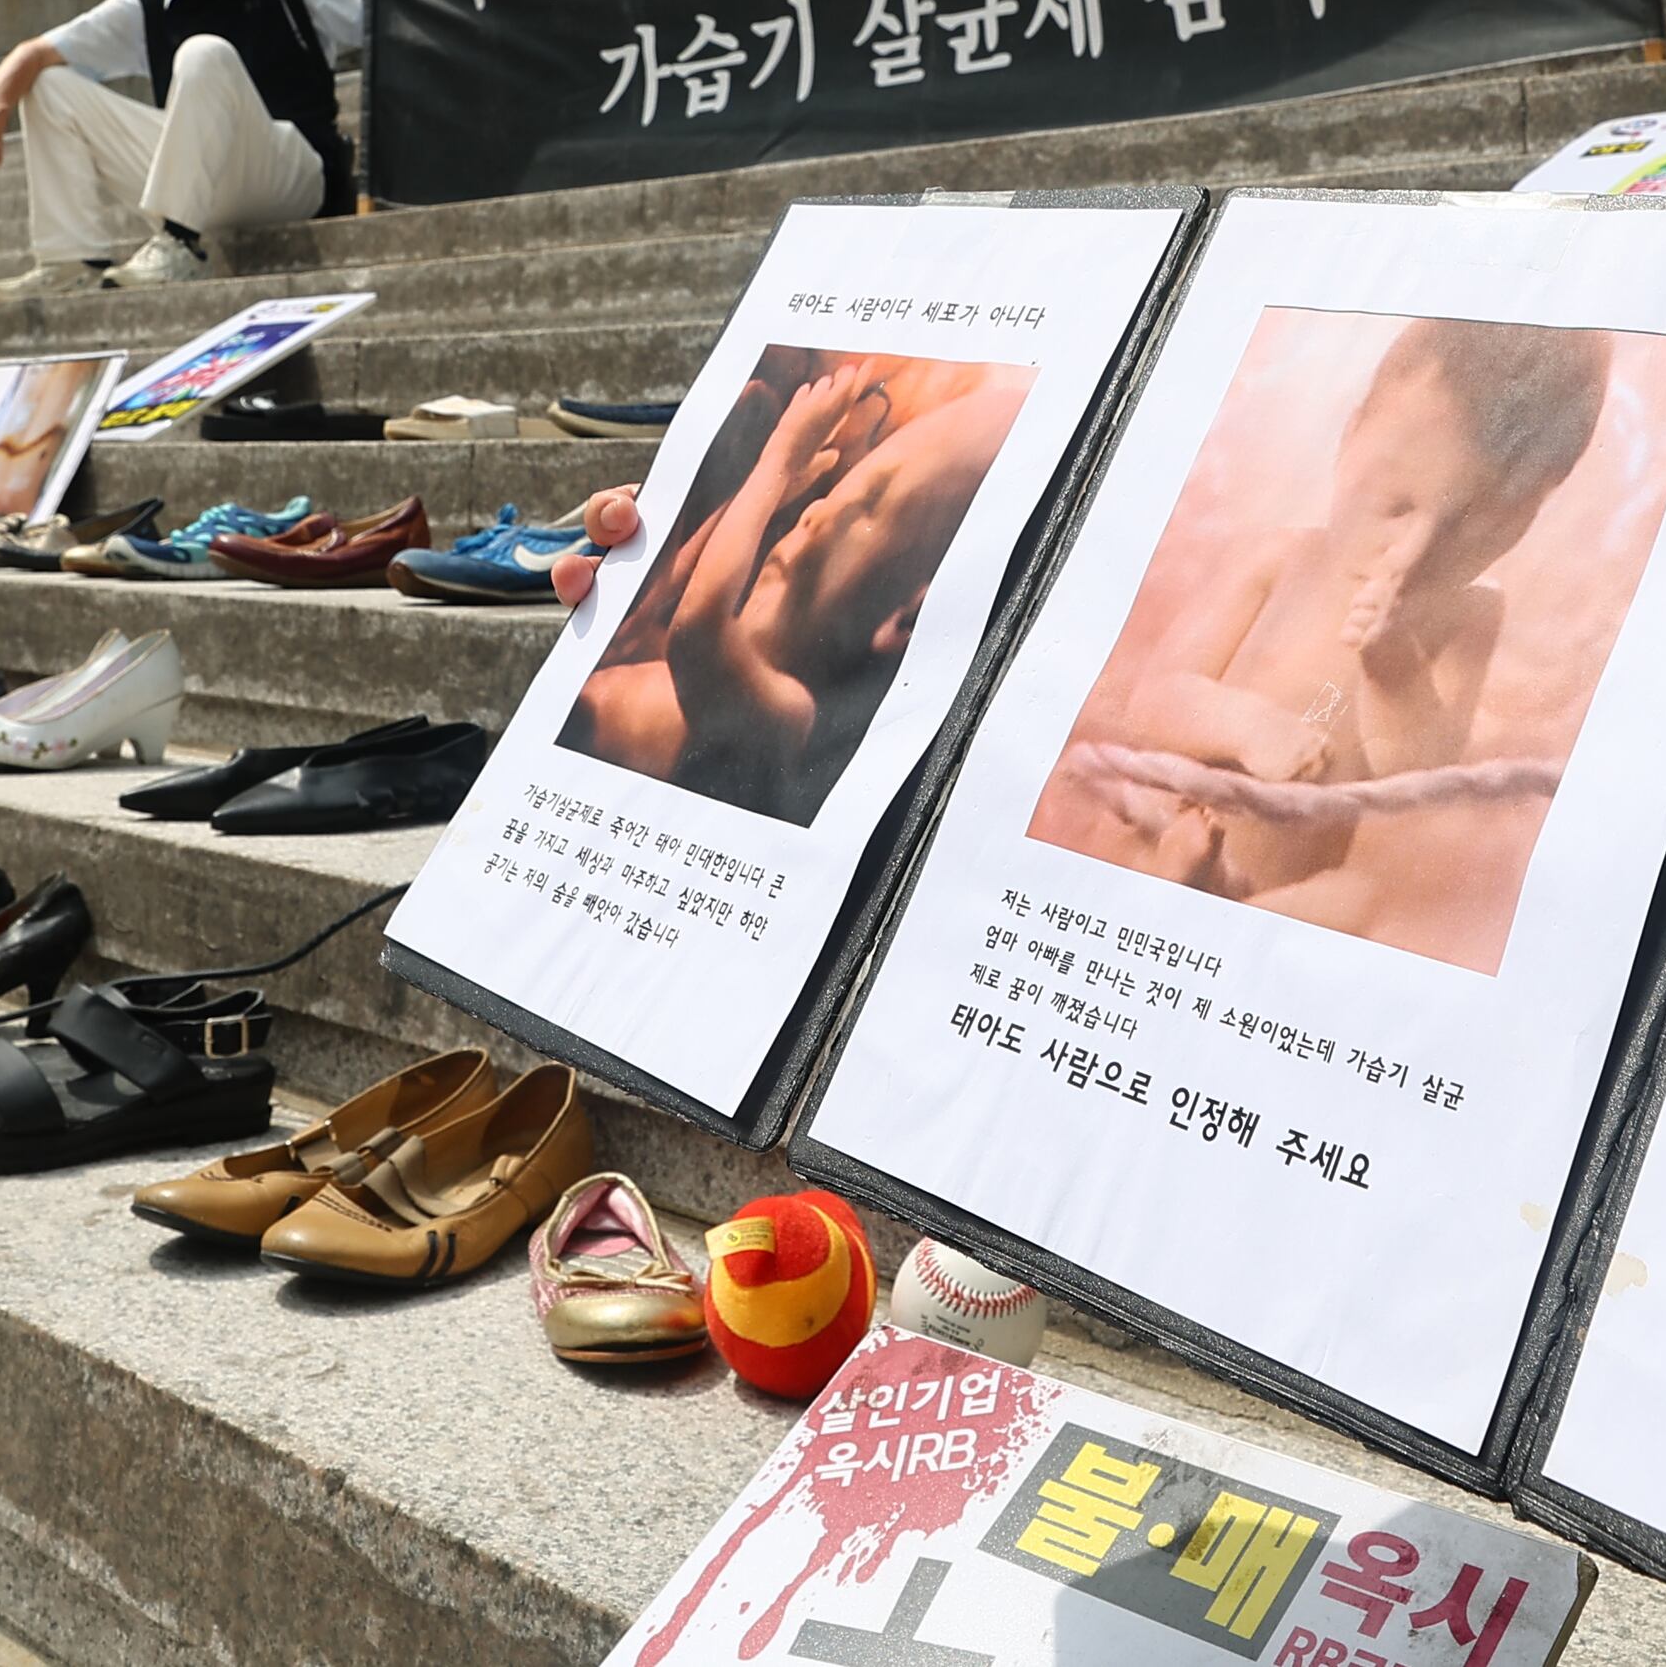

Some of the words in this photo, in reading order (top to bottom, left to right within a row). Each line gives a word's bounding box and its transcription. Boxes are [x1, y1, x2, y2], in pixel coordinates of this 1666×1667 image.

[789, 294, 837, 314] 태아도
[846, 298, 913, 321] 사람이다
[921, 302, 979, 326] 세포가
[990, 306, 1045, 329] 아니다
[503, 818, 529, 844] 꿈을
[534, 830, 568, 855] 가지고
[575, 847, 614, 874] 세상과
[621, 864, 670, 896] 마주하고
[677, 887, 733, 926] 싶었지만
[740, 910, 768, 941] 하얀
[525, 784, 603, 826] 가습기살균제로
[610, 816, 649, 847] 죽어간
[655, 833, 682, 856] 태아
[684, 844, 765, 888] 민대한입니다
[768, 874, 785, 899] 큰
[484, 853, 518, 883] 공기는
[523, 869, 549, 892] 저의
[552, 882, 579, 908] 숨을
[582, 894, 623, 924] 빼앗아
[623, 911, 679, 948] 갔습니다
[1001, 889, 1031, 917] 저는
[1040, 903, 1107, 938] 사람이고
[1117, 927, 1221, 978] 민민국입니다
[970, 963, 1001, 989] 제로
[1008, 977, 1043, 1005] 꿈이
[1050, 992, 1137, 1040] 깨졌습니다
[986, 926, 1018, 952] 엄마
[1028, 940, 1075, 975] 아빠를
[1085, 960, 1135, 997] 만나는
[1146, 981, 1182, 1009] 것이
[1192, 997, 1212, 1020] 제
[1219, 1007, 1336, 1063] 소원이었는데
[1347, 1049, 1409, 1088] 가습기
[1422, 1075, 1464, 1111] 살균
[950, 1004, 1026, 1054] 태아도
[1040, 1038, 1152, 1105] 사람으로
[1169, 1087, 1261, 1148] 인정해
[1276, 1129, 1369, 1189] 주세요
[819, 1370, 1002, 1435] 살인기업
[815, 1428, 981, 1487] 옥시RB
[1320, 1531, 1531, 1667] 옥시
